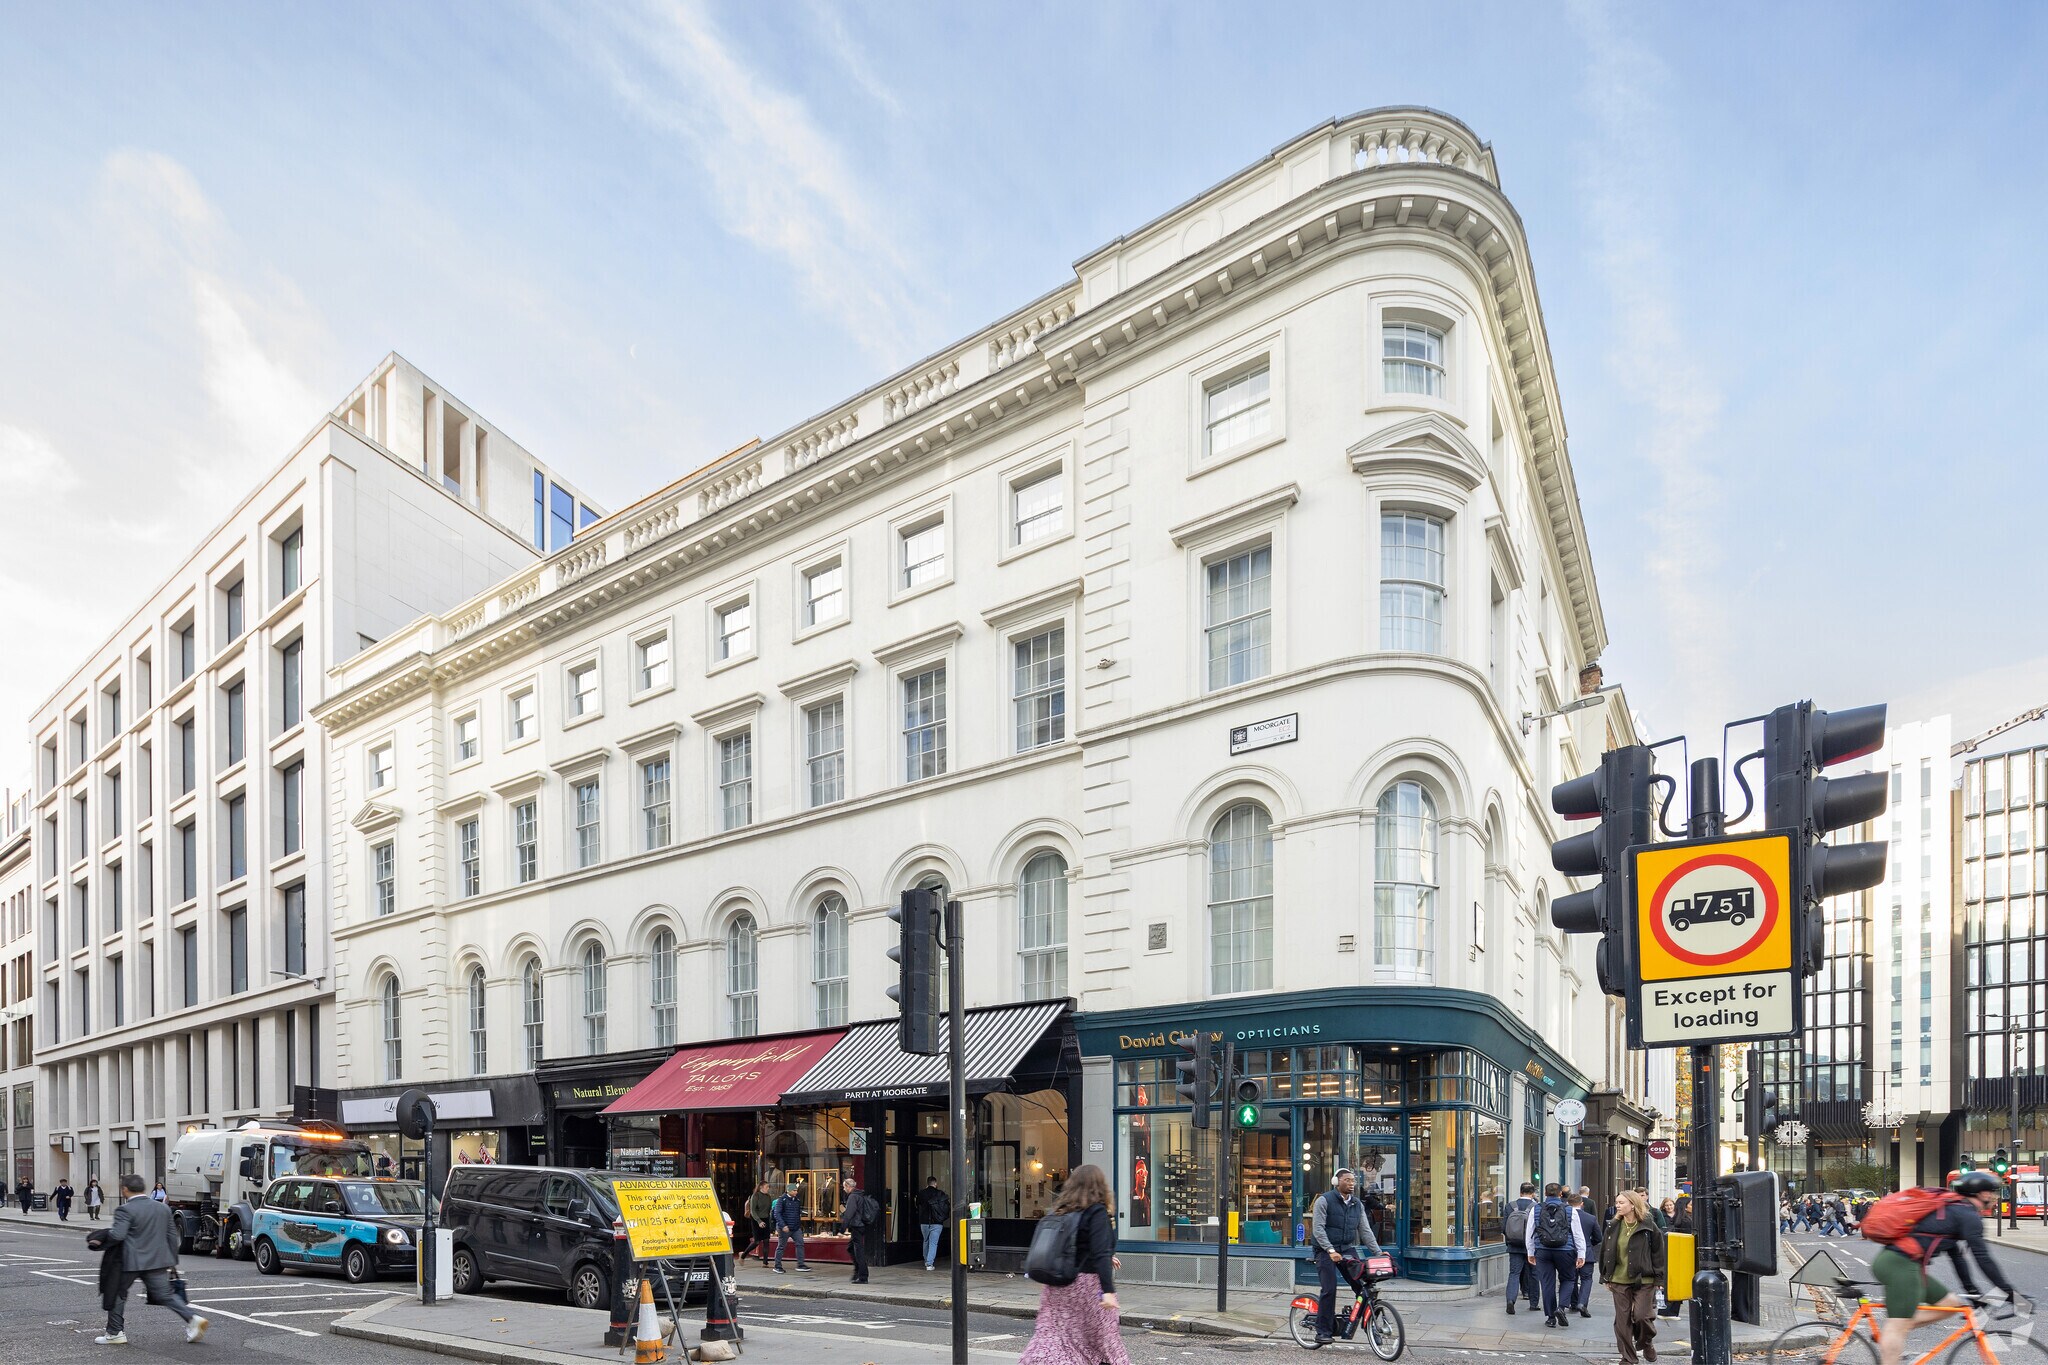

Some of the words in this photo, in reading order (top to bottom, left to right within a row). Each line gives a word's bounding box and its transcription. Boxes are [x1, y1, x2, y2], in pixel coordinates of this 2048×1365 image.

[1253, 718, 1291, 732] MOORGATE
[1654, 985, 1736, 1006] Except
[1743, 982, 1777, 999] for
[1674, 1009, 1759, 1029] loading
[1236, 1024, 1321, 1040] OPTICIANS
[1119, 1032, 1166, 1050] David
[680, 1043, 814, 1074] Copperfield
[686, 1071, 762, 1084] TAILORS
[573, 1086, 603, 1098] Natural
[605, 1085, 634, 1096] Eleme
[845, 1091, 870, 1099] PARTY
[882, 1087, 928, 1097] MOORGATE
[620, 1147, 643, 1156] Natural
[644, 1146, 660, 1156] Elem
[619, 1180, 668, 1189] ADVANCED
[669, 1180, 708, 1189] WARNING
[647, 1203, 672, 1211] CRANE
[679, 1216, 686, 1224] 2
[685, 1216, 709, 1224] day(s)
